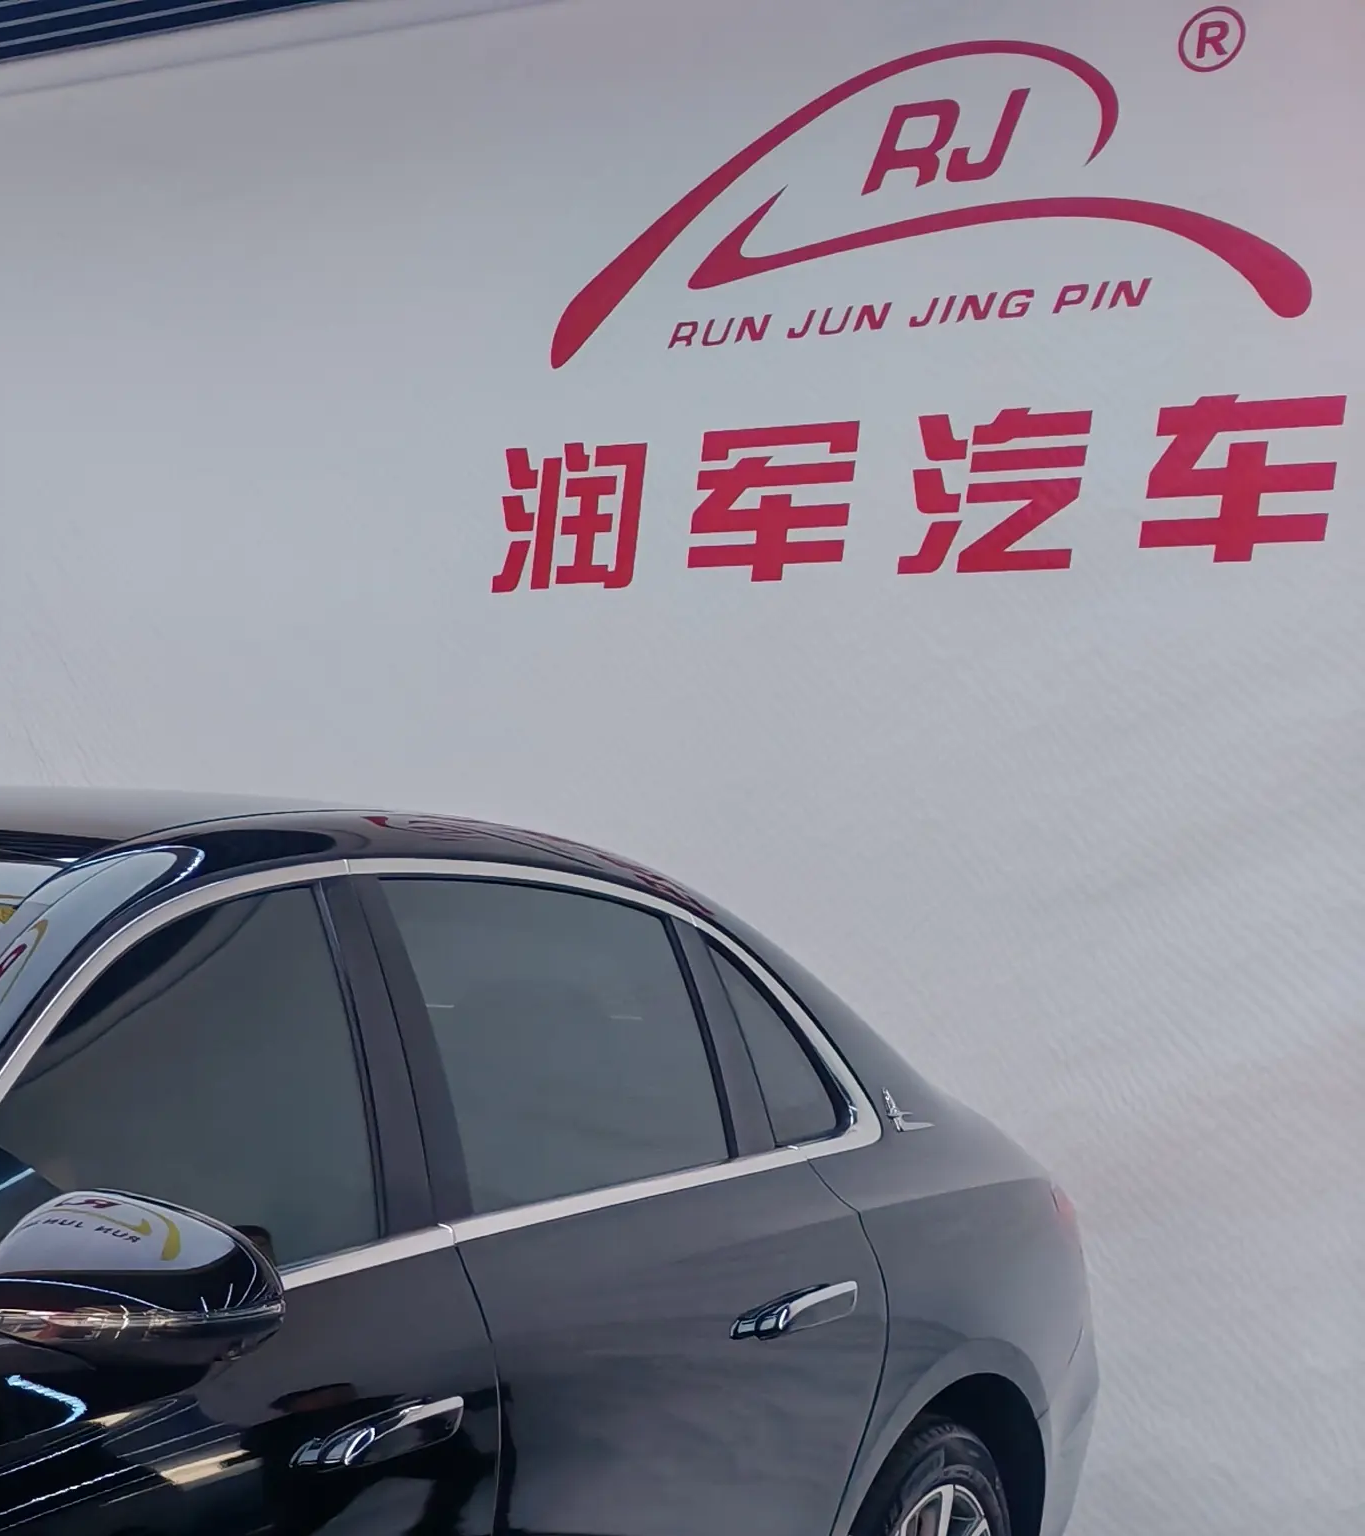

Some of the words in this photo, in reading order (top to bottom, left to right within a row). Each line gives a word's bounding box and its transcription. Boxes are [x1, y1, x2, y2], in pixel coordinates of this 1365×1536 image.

[860, 87, 1031, 196] RJ
[668, 313, 772, 349] RUN
[786, 301, 893, 339] JUN
[908, 288, 1035, 329] JING
[1052, 277, 1153, 315] PIN
[491, 394, 1348, 594] 润军汽车
